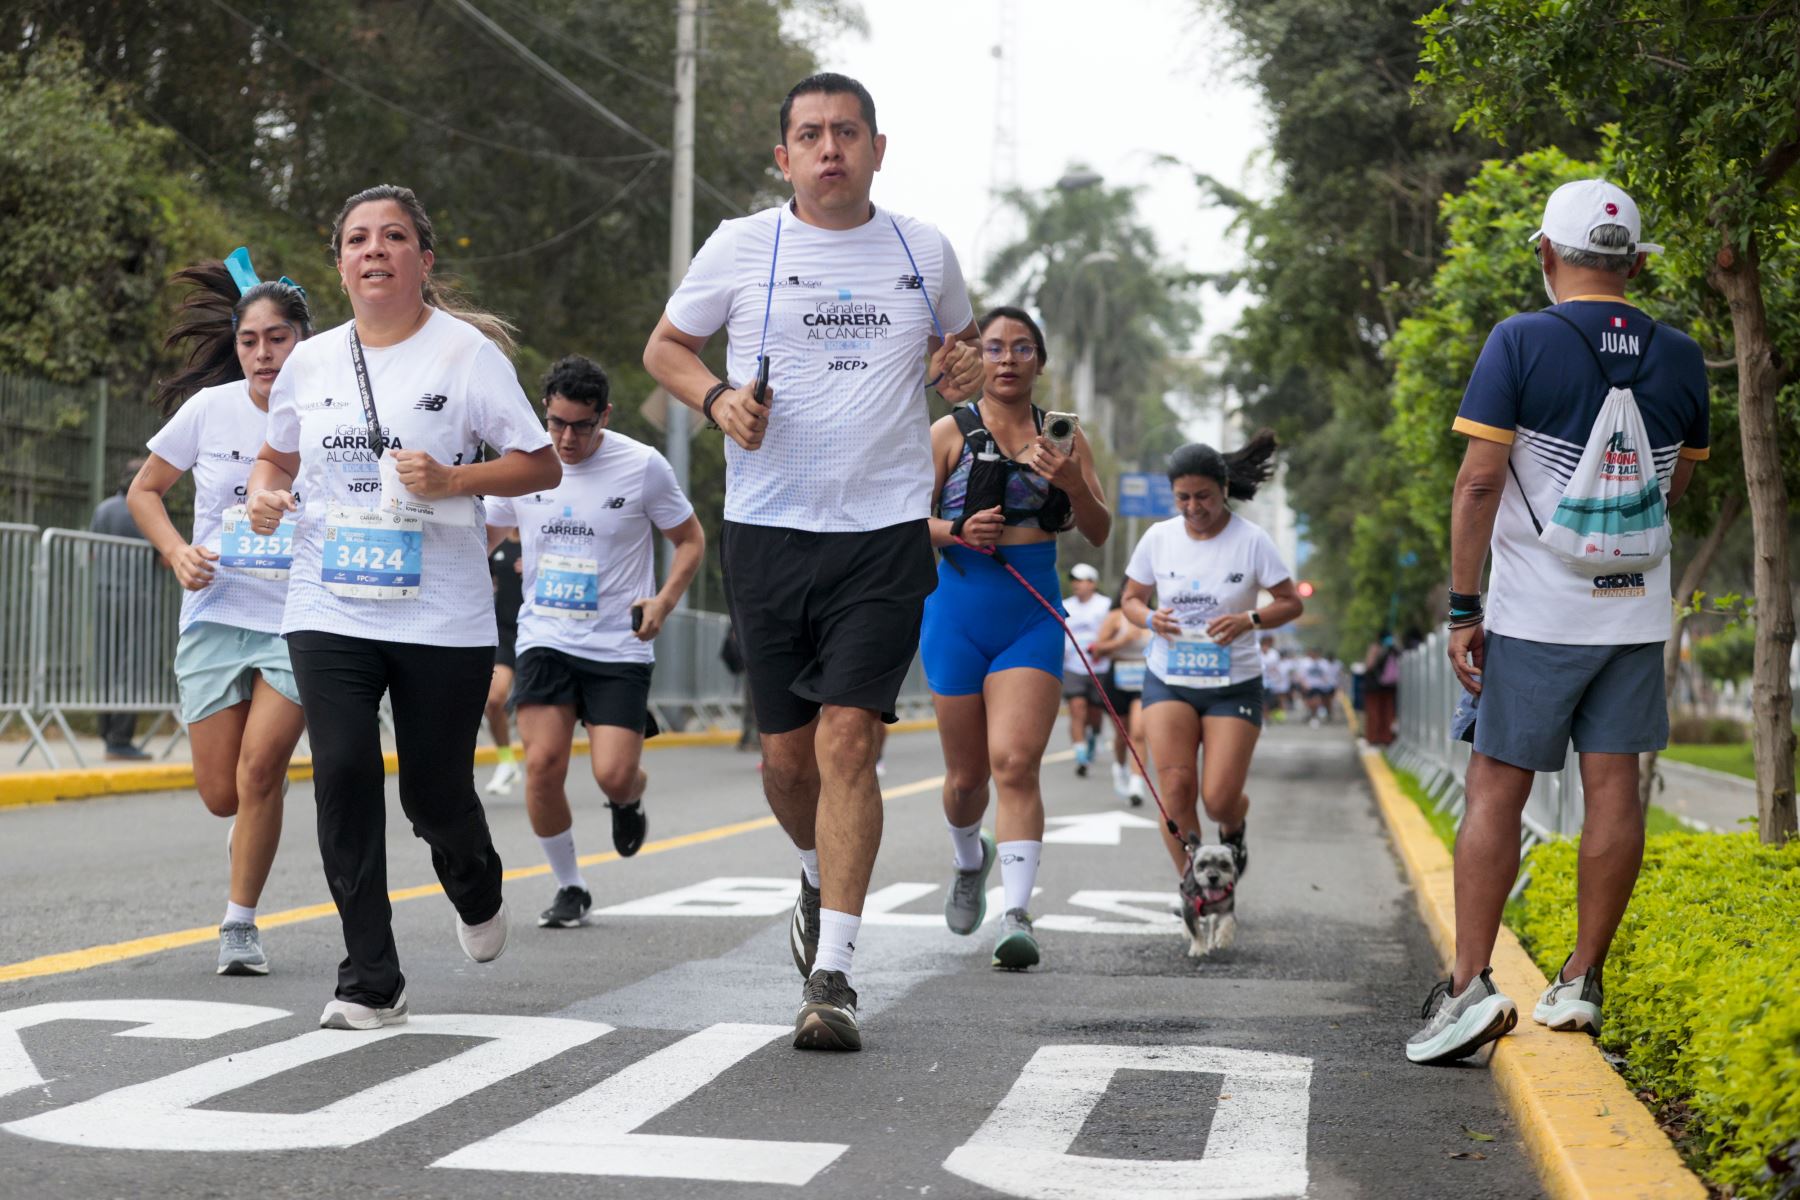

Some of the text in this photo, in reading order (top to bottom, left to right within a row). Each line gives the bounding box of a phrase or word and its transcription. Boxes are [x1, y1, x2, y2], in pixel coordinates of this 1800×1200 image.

[865, 302, 876, 313] la
[803, 313, 891, 326] CARRERA
[807, 325, 888, 340] AL CÁNCER!
[1600, 331, 1640, 356] JUAN
[335, 424, 369, 436] ¡Gána
[326, 448, 379, 463] AL CÁNC
[405, 505, 417, 513] love
[541, 525, 595, 537] CARRERA
[237, 535, 293, 556] 3252
[336, 545, 404, 571] 3424
[1593, 572, 1645, 589] GRONE
[544, 580, 585, 600] 3475
[1594, 588, 1645, 598] RUNNERS
[1176, 653, 1219, 668] 3202
